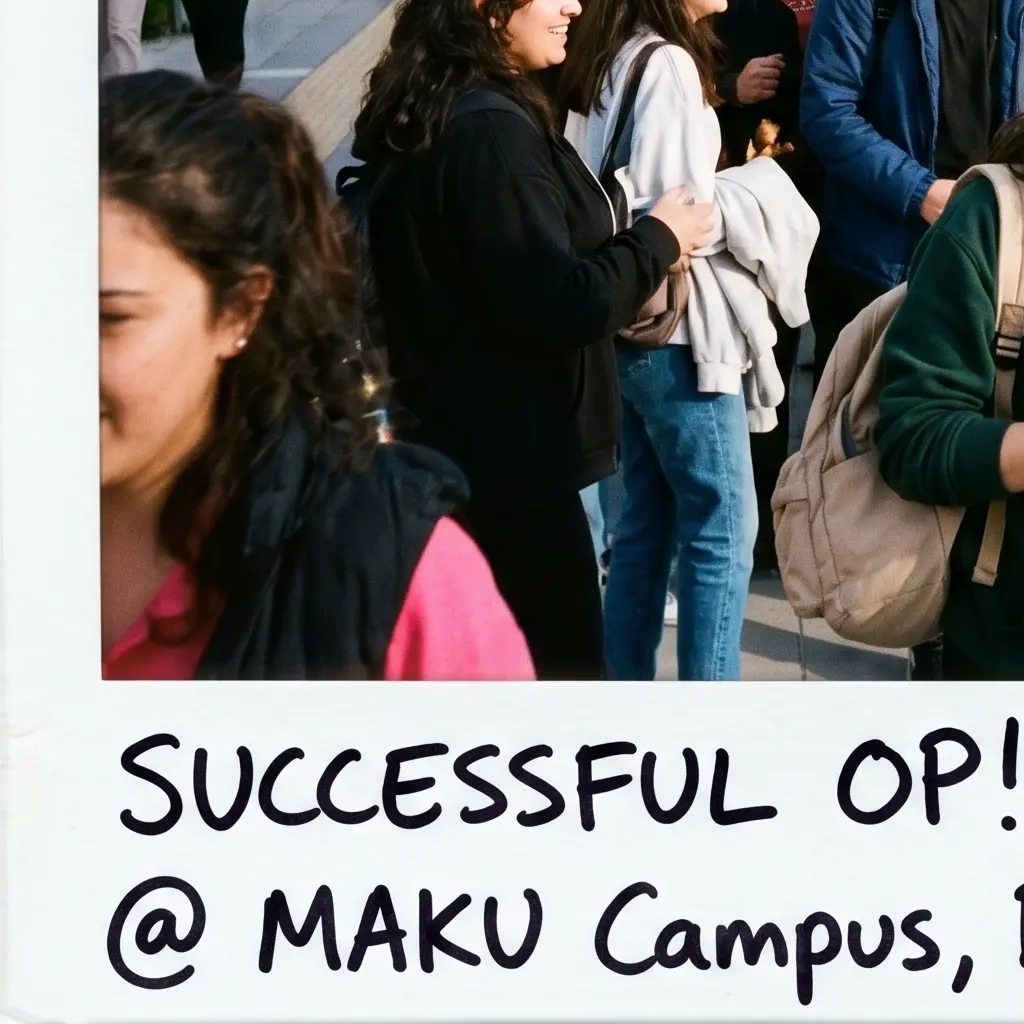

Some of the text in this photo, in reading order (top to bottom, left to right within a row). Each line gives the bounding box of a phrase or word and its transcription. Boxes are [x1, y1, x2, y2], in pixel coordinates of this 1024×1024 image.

[119, 733, 778, 836] SUCCESSFUL
[836, 716, 1020, 832] OP!
[106, 875, 207, 990] @
[258, 884, 543, 974] MAKU
[594, 881, 974, 1006] Campus,
